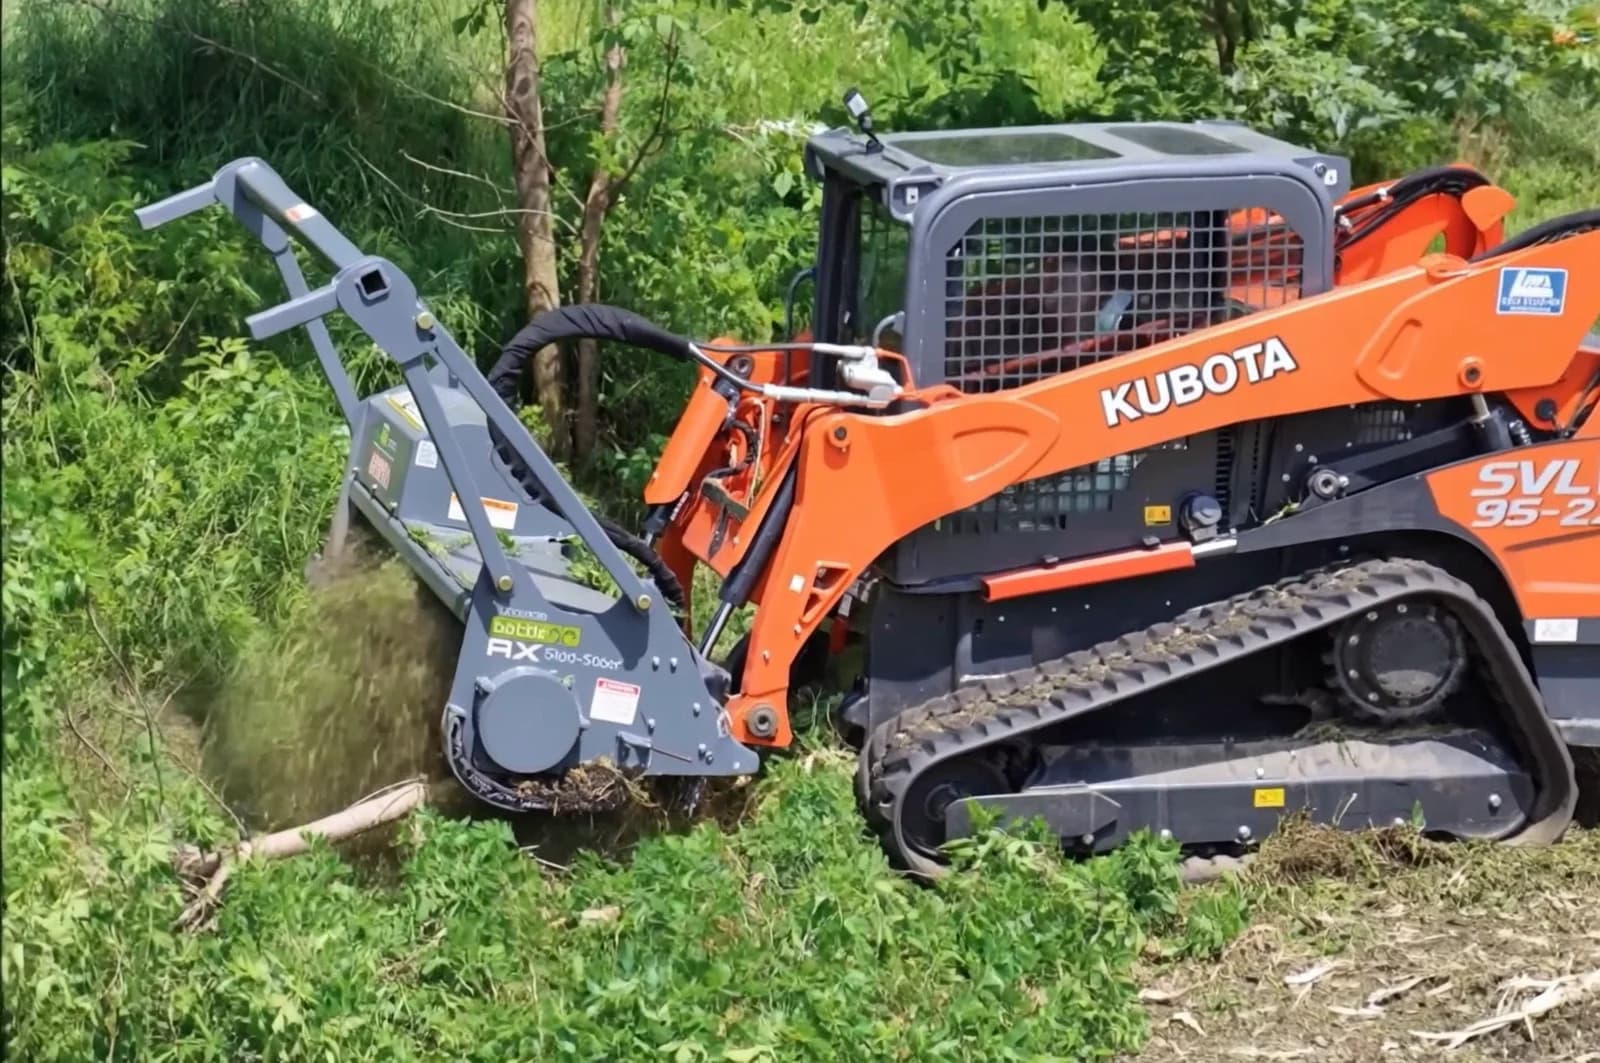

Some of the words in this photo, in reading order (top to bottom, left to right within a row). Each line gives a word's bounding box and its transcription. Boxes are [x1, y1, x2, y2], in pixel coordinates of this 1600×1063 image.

[1100, 336, 1298, 427] KUBOTA
[1470, 459, 1591, 497] SVL
[1471, 497, 1600, 528] 95-2
[486, 637, 544, 662] AX
